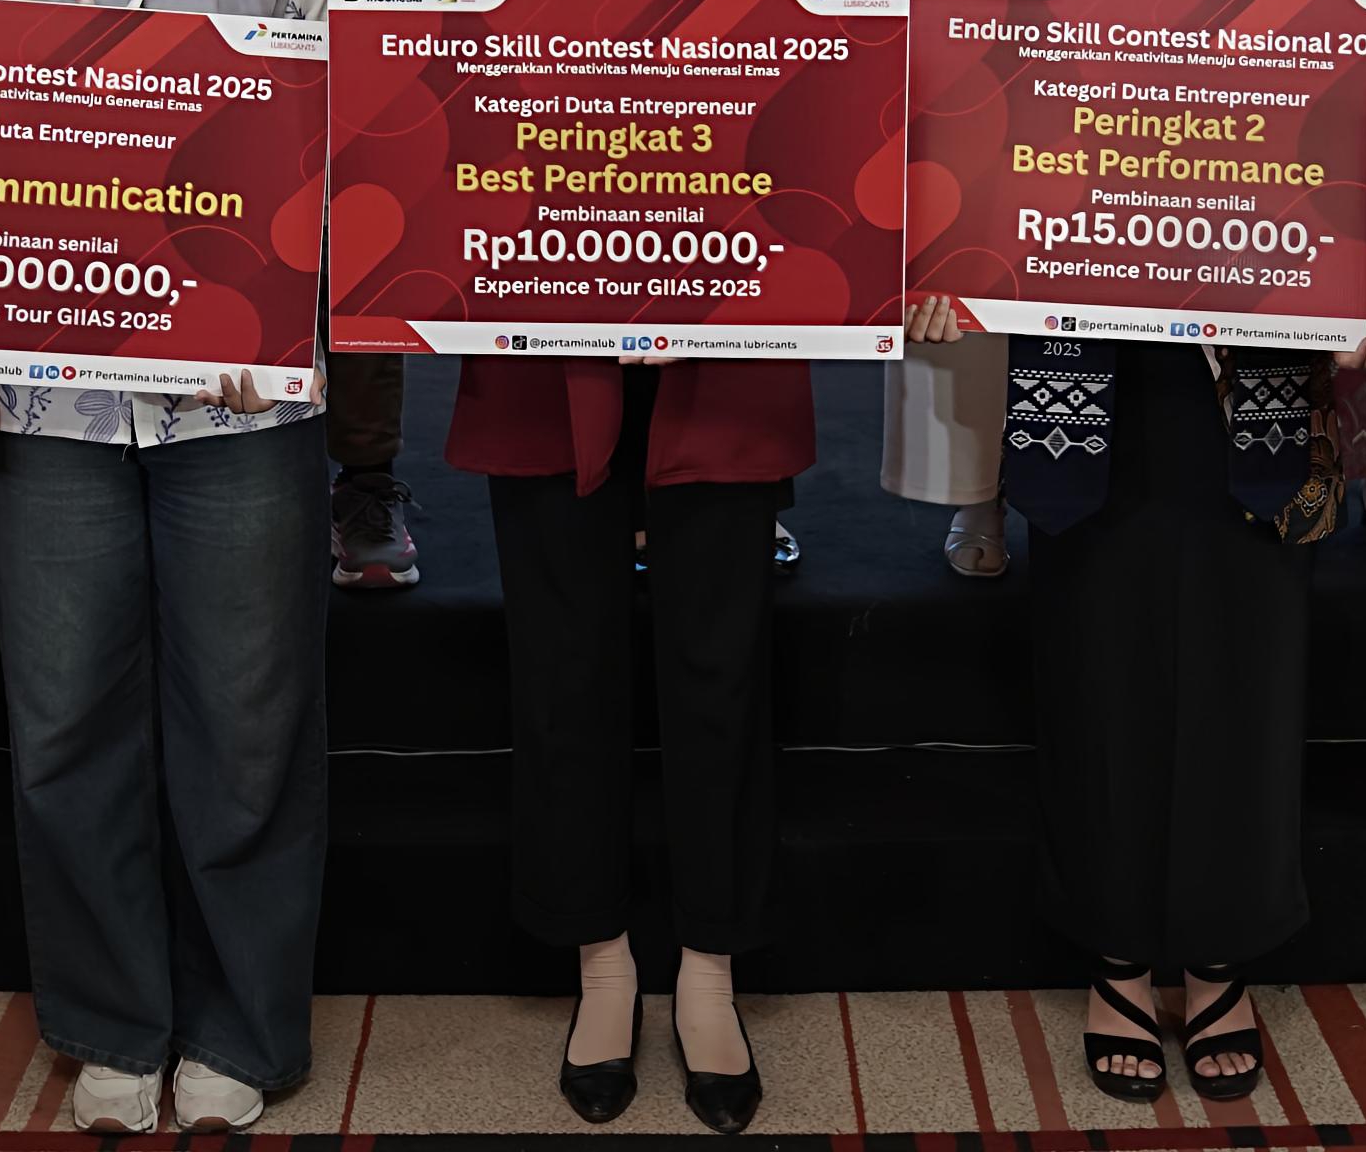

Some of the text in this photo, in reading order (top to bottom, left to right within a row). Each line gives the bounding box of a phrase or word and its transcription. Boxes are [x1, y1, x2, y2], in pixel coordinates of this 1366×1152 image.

[383, 34, 848, 60] Enduro Skill Contest Nasional 2025
[949, 18, 1039, 41] Enduro
[1047, 22, 1100, 44] Skill
[1108, 25, 1210, 48] Contest
[1218, 29, 1331, 53] Nasional
[85, 67, 200, 95] Nasional
[207, 76, 272, 100] 2025
[517, 122, 712, 158] Peringkat 3
[1074, 107, 1264, 145] Peringkat 2
[457, 164, 771, 194] Best Performance
[1013, 145, 1323, 185] Best Performance
[539, 206, 703, 222] Pembinaan senilai
[1092, 190, 1255, 211] Pembinaan senilai
[59, 237, 118, 253] senilai
[464, 229, 784, 271] Rp10.000.000,-
[1019, 209, 1334, 263] Rp15.000.000,-
[1027, 257, 1310, 287] Experience Tour GIIAS 2025
[475, 277, 760, 298] Experience Tour GIIAS 2025
[4, 305, 52, 323] Tour
[58, 308, 115, 327] GIIAS
[120, 312, 171, 330] 2025
[1043, 342, 1081, 356] 2025
